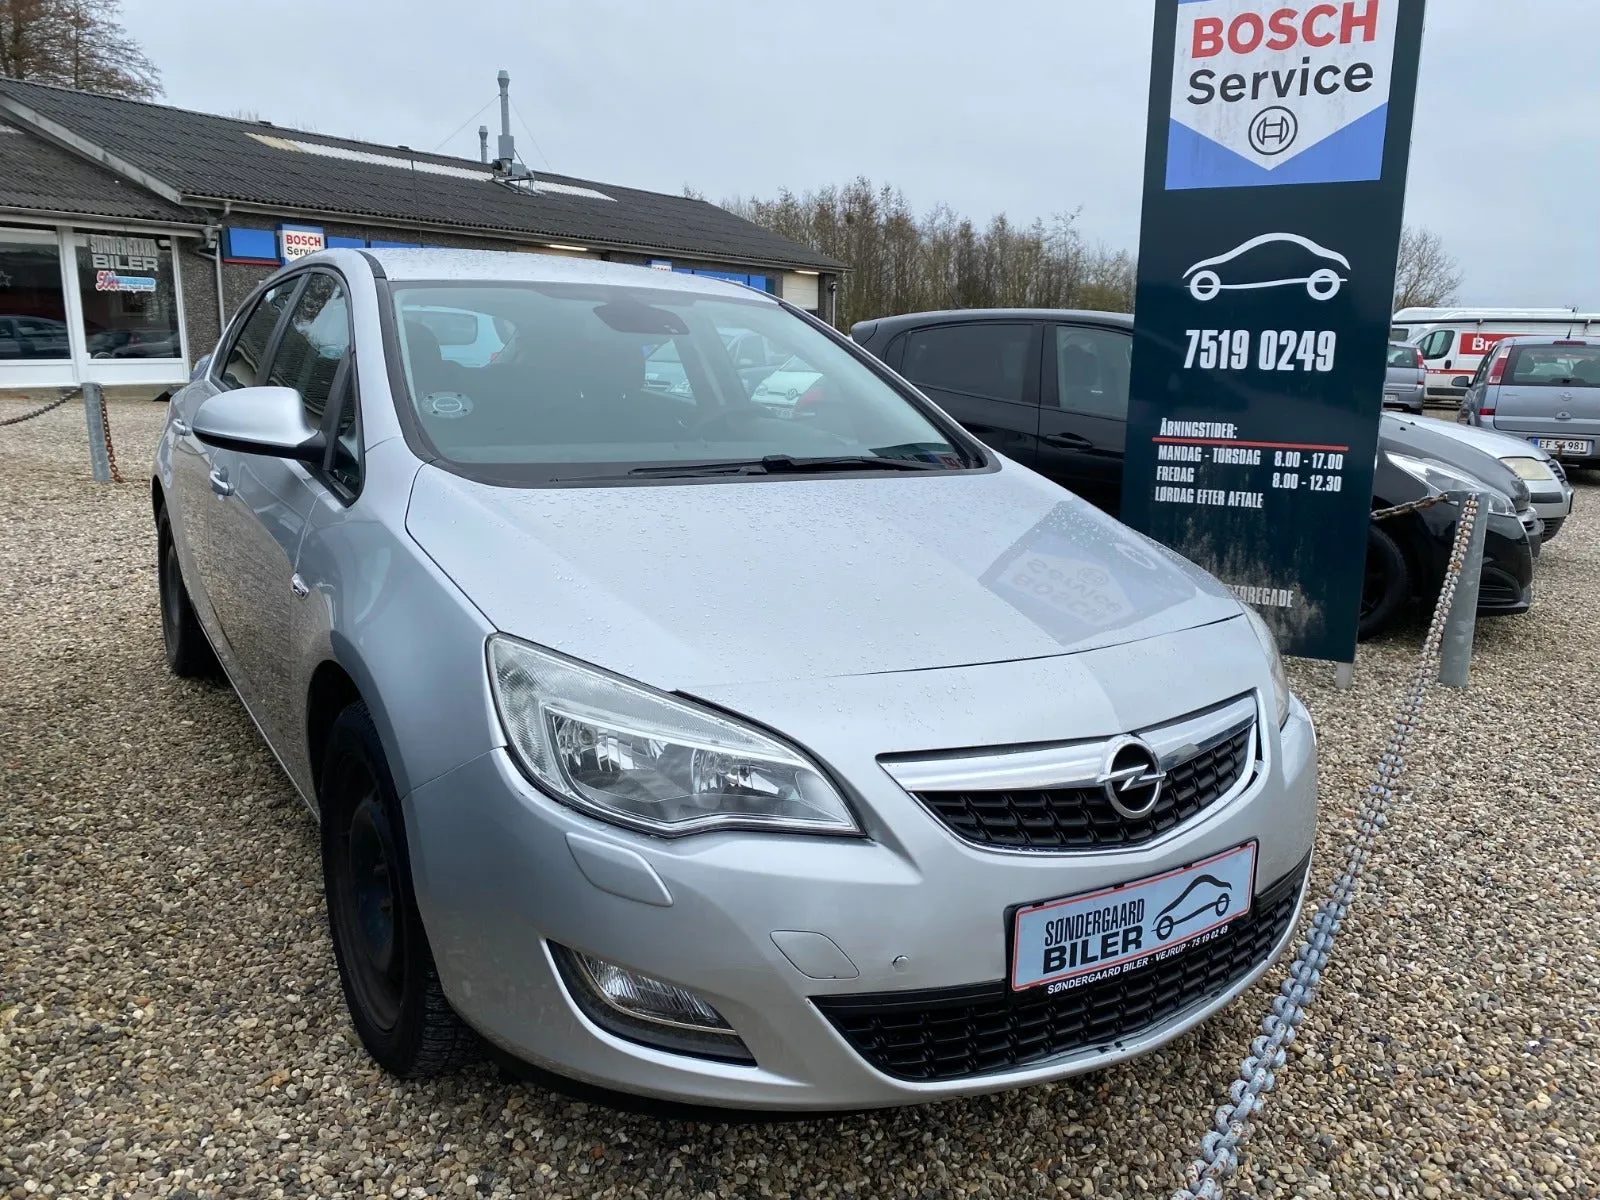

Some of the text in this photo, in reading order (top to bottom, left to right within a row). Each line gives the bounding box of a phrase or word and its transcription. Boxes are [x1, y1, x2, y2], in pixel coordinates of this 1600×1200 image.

[1191, 0, 1379, 58] BOSCH
[1187, 56, 1374, 105] Service
[286, 234, 322, 247] BOSCH
[92, 254, 159, 271] BILER
[1184, 329, 1337, 372] 7519 0249
[1160, 418, 1238, 439] ÅBNINGSTIDER:
[1157, 446, 1202, 462] MANDAG
[1212, 448, 1261, 466] TORSDAG
[1274, 452, 1301, 468] 8.00
[1312, 454, 1344, 470] 17.00
[1540, 440, 1552, 448] EF
[1568, 441, 1584, 450] 981
[1156, 466, 1195, 484] FREDAG
[1271, 473, 1299, 489] 8.00
[1309, 475, 1342, 492] 12.30
[1154, 487, 1264, 508] LØRDAG EFTER AFTALE
[1045, 899, 1144, 946] SØNDERGAARD
[1043, 925, 1143, 974] BILER
[1048, 966, 1121, 994] SØNDERGAARD
[1123, 958, 1149, 973] BILER
[1155, 943, 1186, 960] VEJRUP
[1191, 939, 1202, 948] 75
[1202, 935, 1211, 944] 19
[1211, 930, 1219, 941] 02
